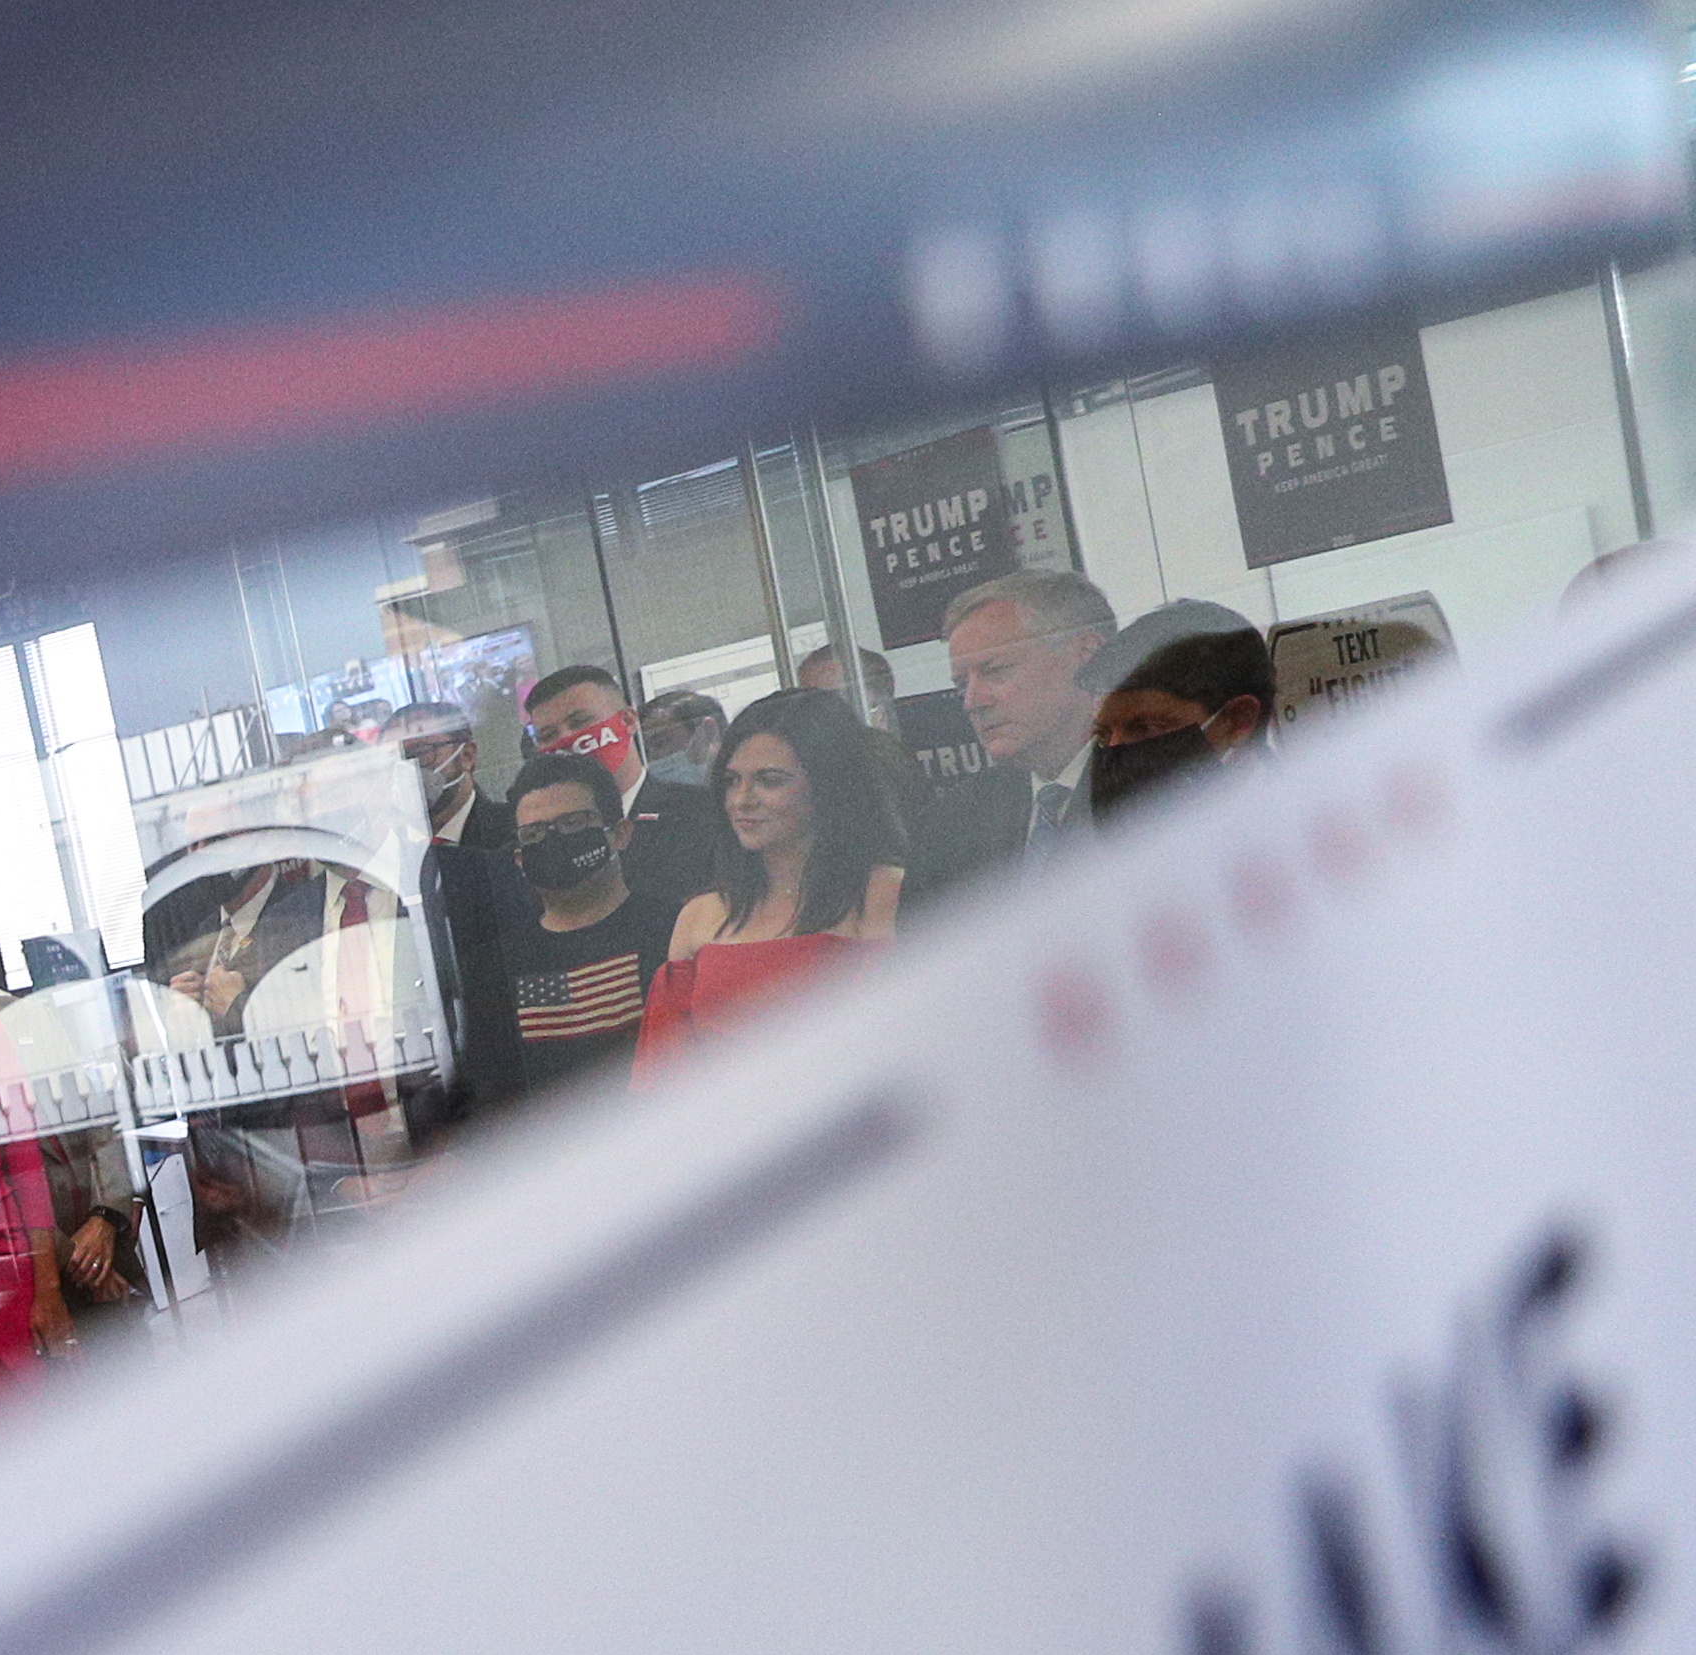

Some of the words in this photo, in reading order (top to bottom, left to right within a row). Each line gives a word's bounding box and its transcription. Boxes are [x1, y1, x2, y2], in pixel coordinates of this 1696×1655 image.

[1236, 365, 1406, 446] TRUMP
[1258, 416, 1398, 476] PENCE
[869, 488, 988, 548] TRUMP
[886, 531, 985, 573] PENCE
[1332, 628, 1379, 665] TEXT
[555, 727, 619, 756] GA
